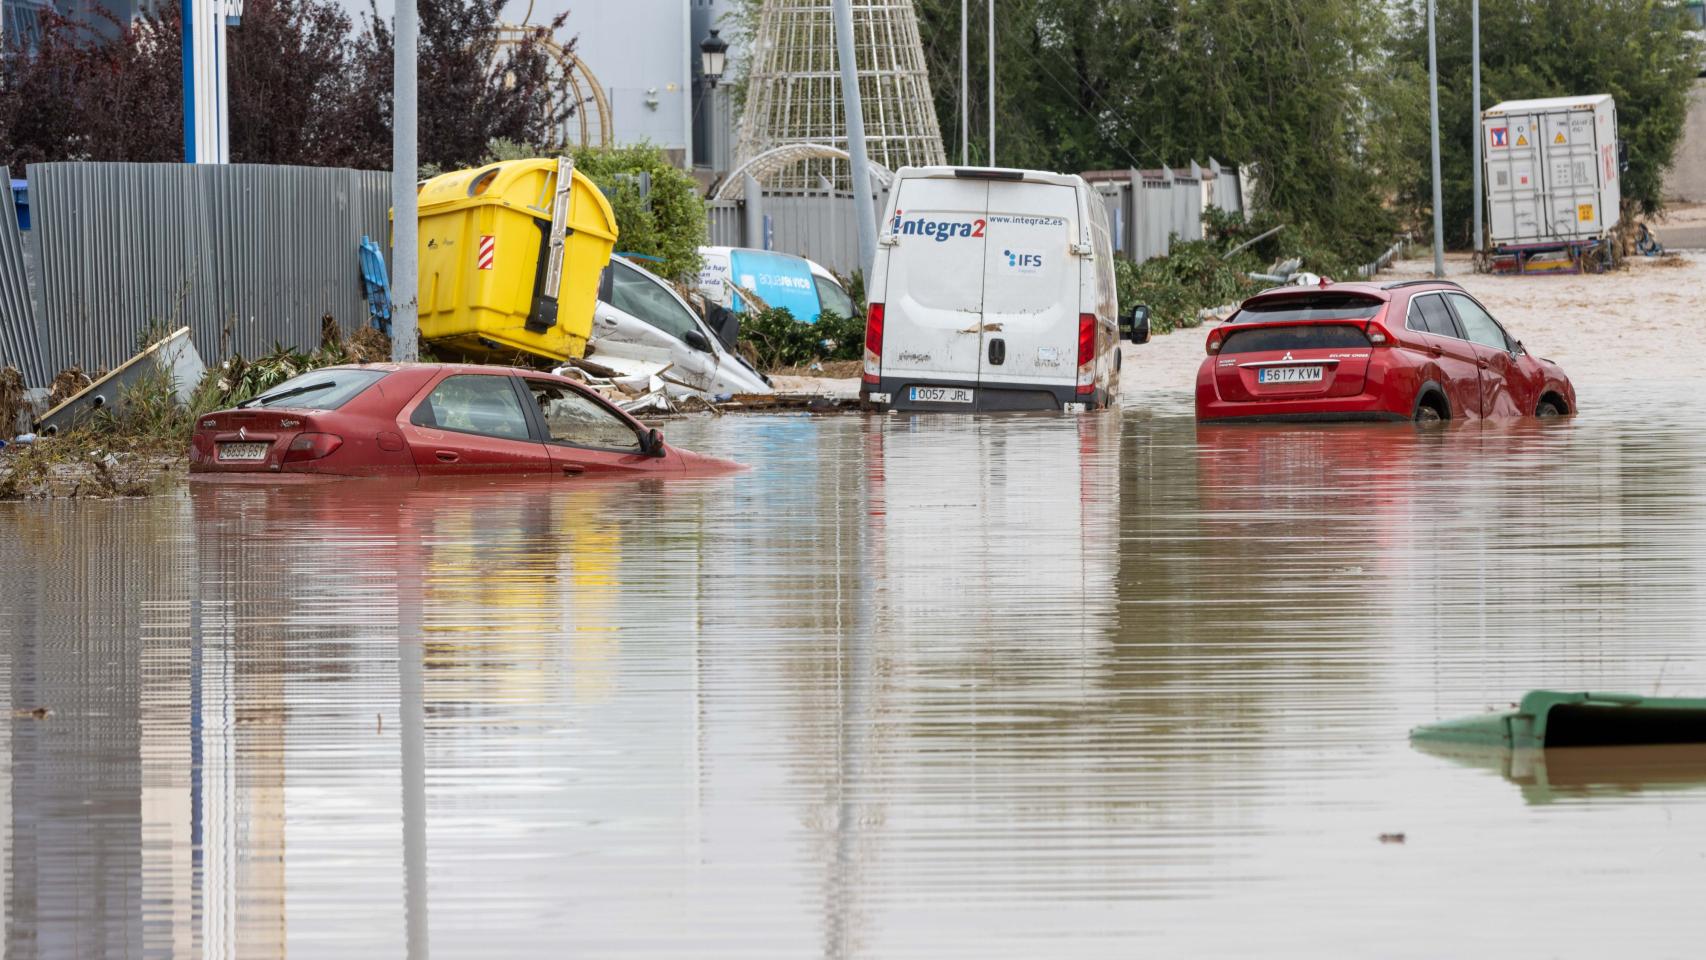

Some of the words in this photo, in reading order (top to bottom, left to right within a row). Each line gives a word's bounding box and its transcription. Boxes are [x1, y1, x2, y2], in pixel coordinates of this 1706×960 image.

[892, 209, 986, 242] integra2
[989, 216, 1063, 226] www.integra2.es
[1018, 254, 1042, 267] IFS
[713, 264, 727, 273] hay
[1266, 369, 1295, 381] 5617
[1298, 367, 1320, 380] KVM
[918, 388, 945, 400] 0057
[950, 390, 970, 401] JRL
